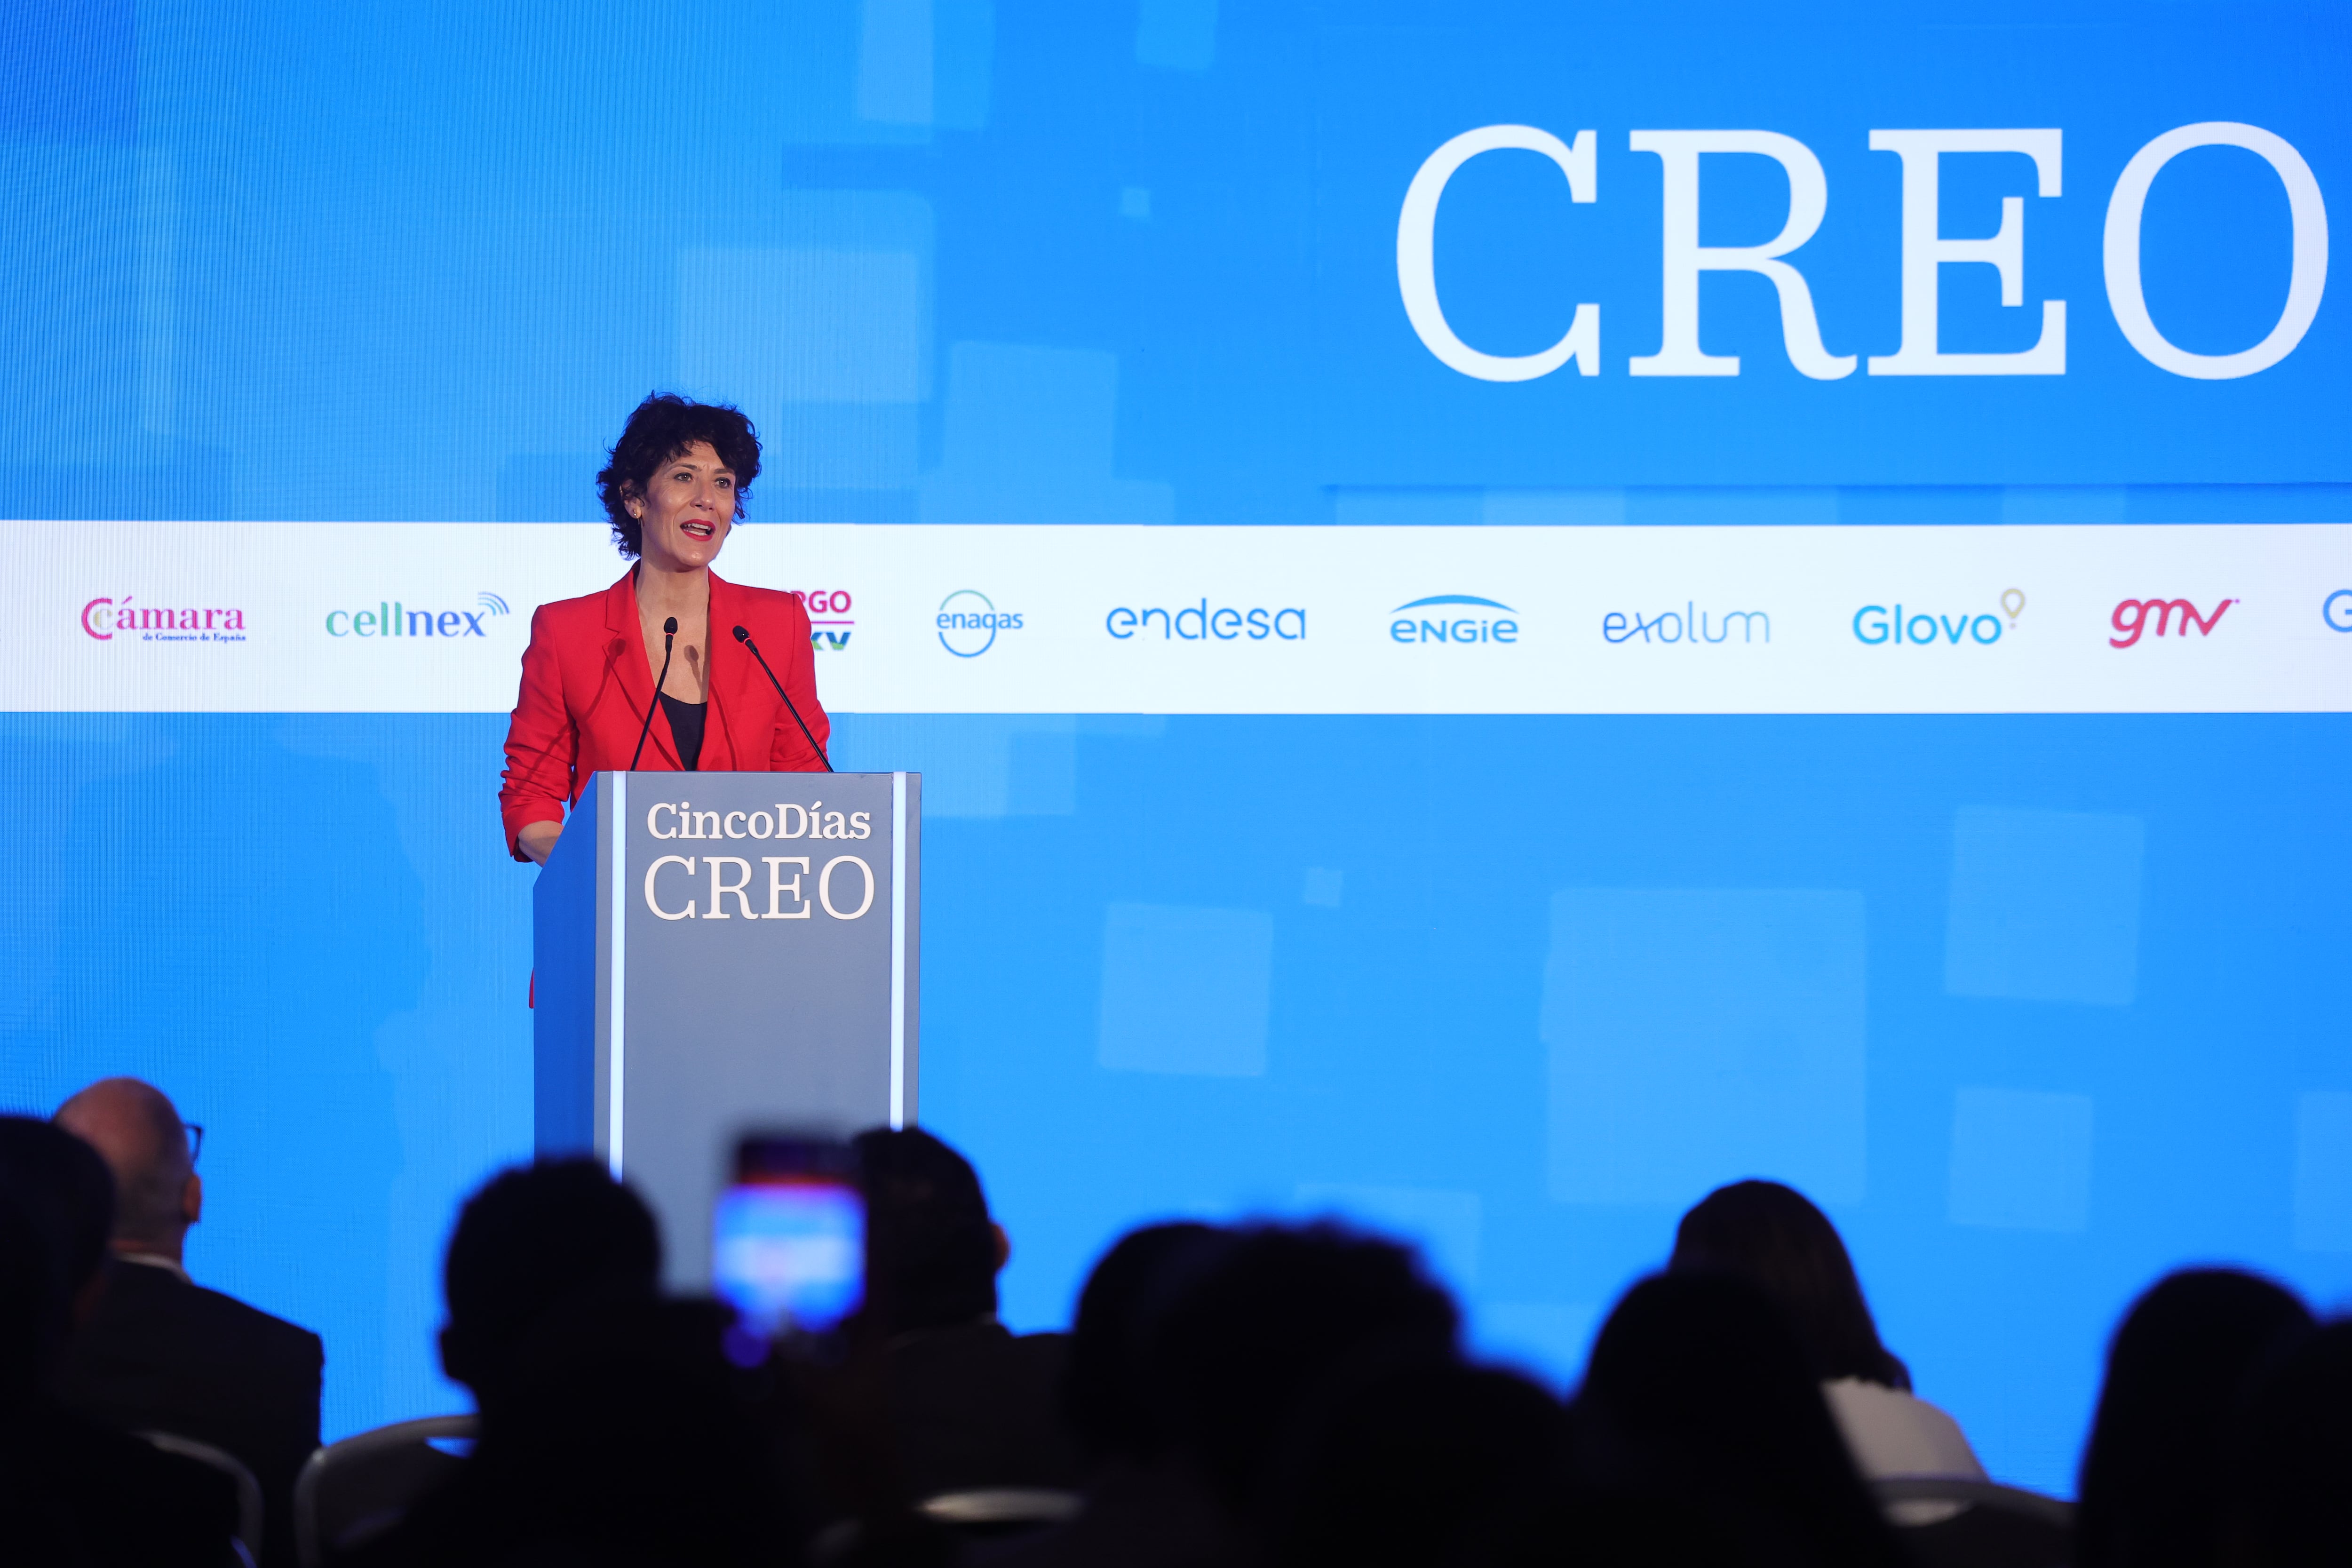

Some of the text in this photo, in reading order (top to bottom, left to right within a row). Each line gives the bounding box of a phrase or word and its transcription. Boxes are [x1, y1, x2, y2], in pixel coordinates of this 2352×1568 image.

[1397, 122, 2328, 382] CREO
[81, 596, 245, 640] Cámara
[326, 602, 486, 637] cellnex
[790, 590, 851, 613] GO
[1106, 597, 1306, 640] endesa
[1603, 600, 1770, 644] exolum
[810, 631, 851, 650] KV
[1852, 604, 2002, 645] Glovo
[2109, 598, 2233, 649] gmv
[647, 801, 871, 839] CincoDías
[644, 855, 874, 920] CREO
